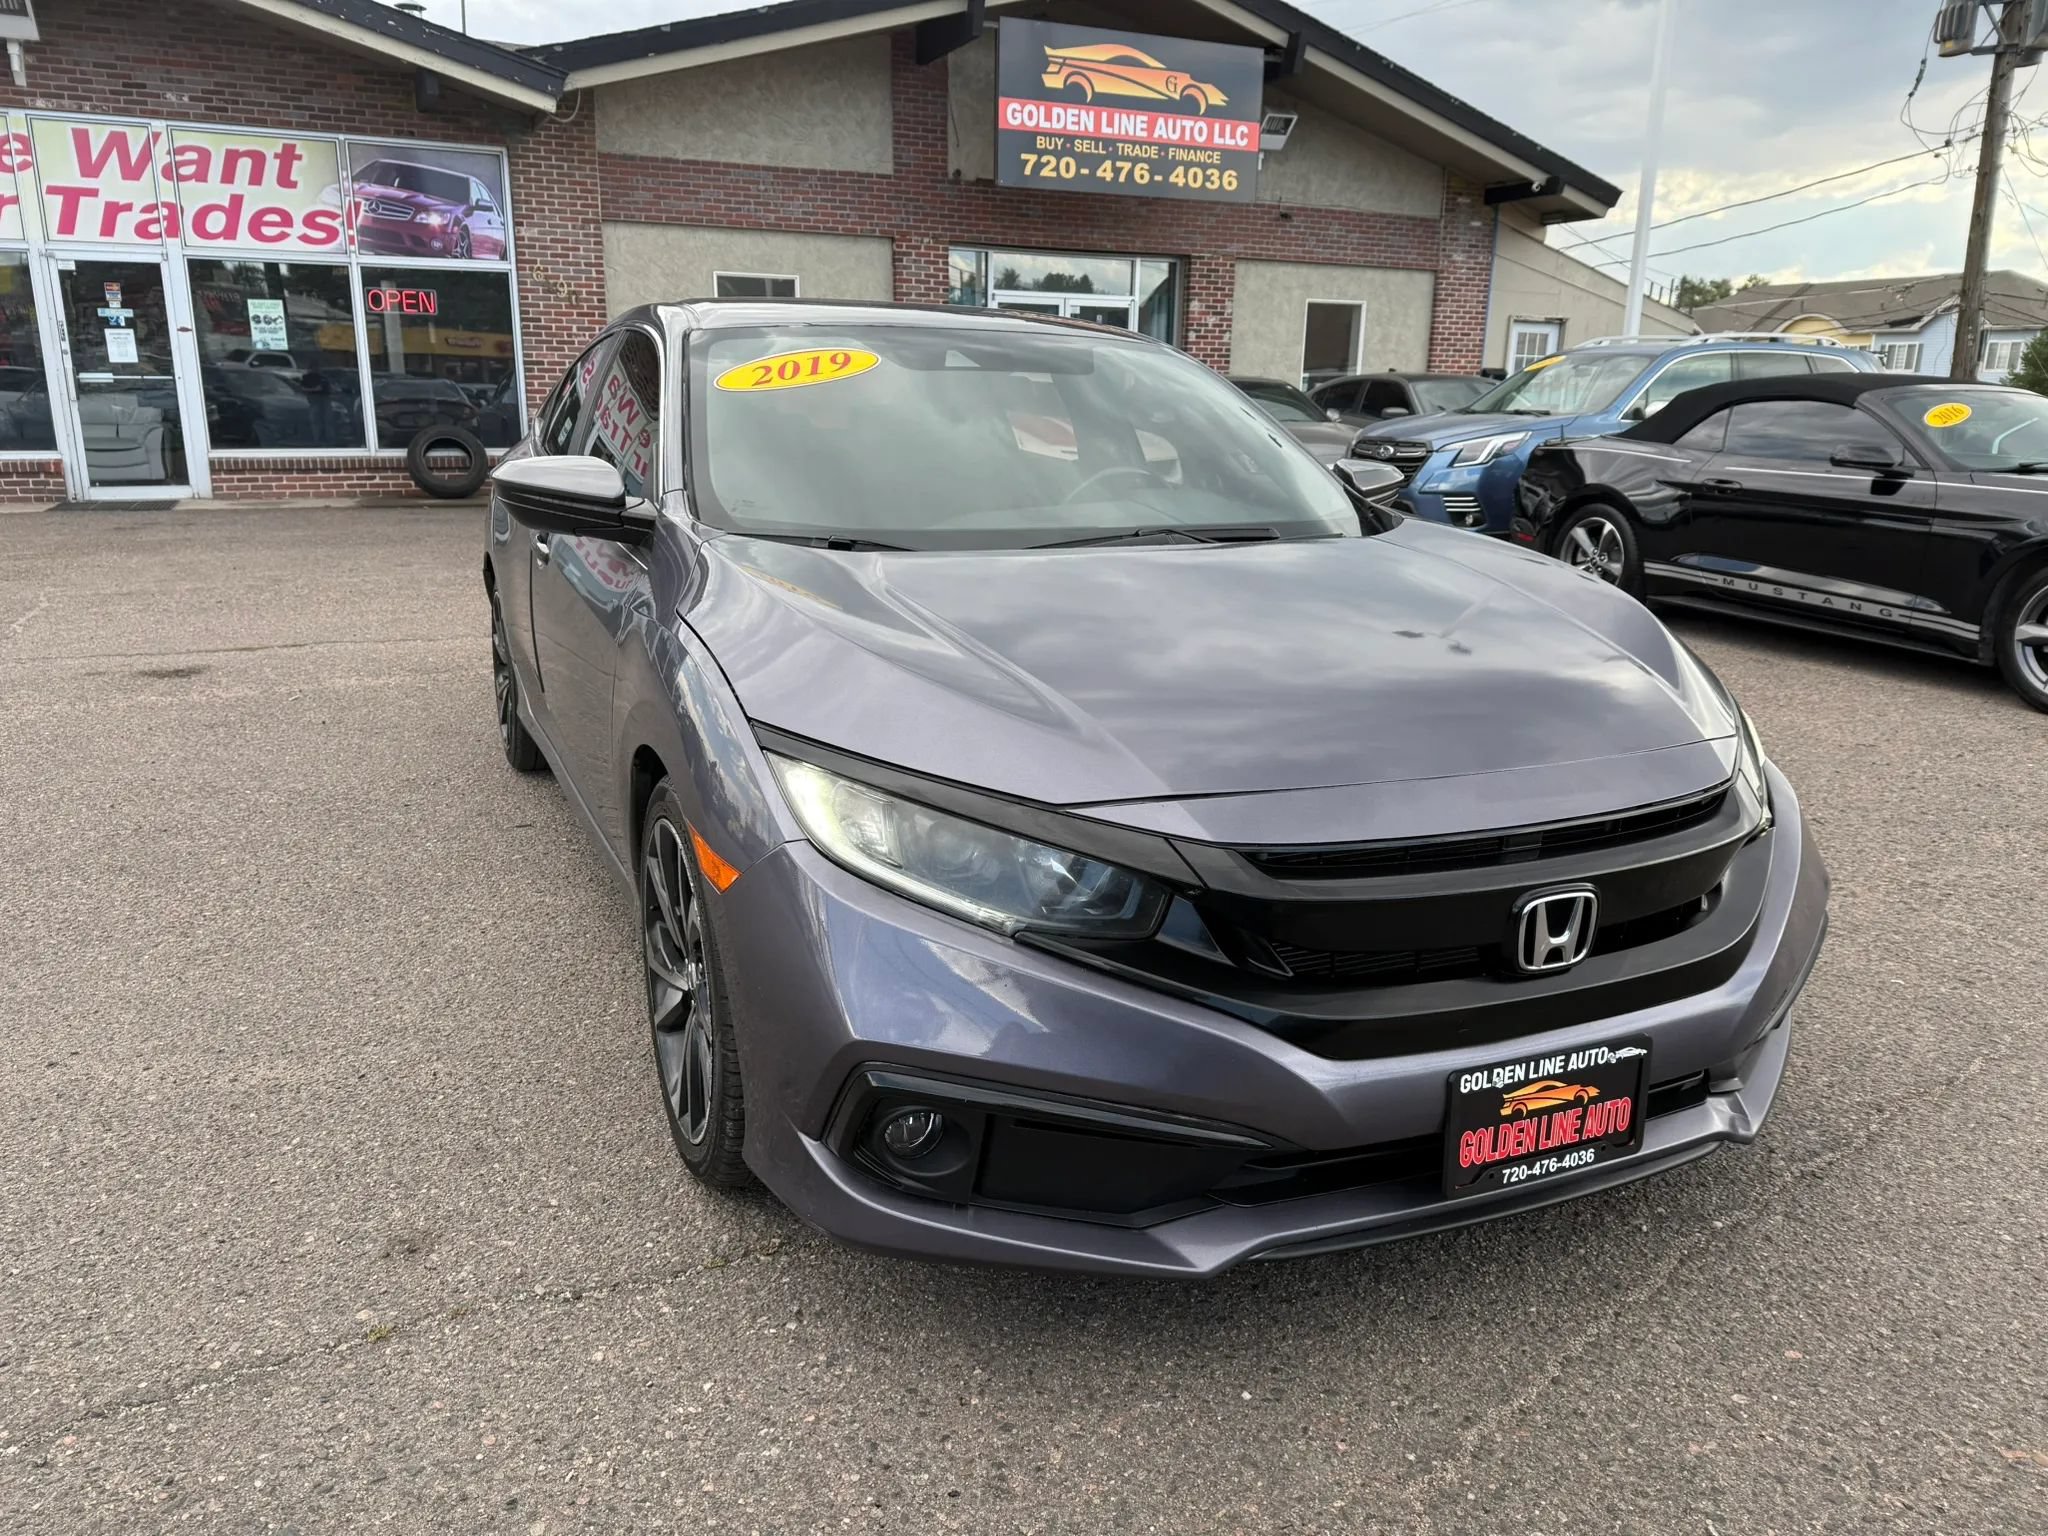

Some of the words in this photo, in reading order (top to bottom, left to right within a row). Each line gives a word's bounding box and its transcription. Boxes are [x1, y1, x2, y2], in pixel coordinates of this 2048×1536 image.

[1006, 102, 1095, 133] GOLDEN
[1101, 112, 1148, 138] LINE
[1153, 117, 1208, 143] AUTO
[1213, 123, 1249, 147] LLC
[71, 127, 303, 190] Want
[1036, 135, 1064, 150] BUY
[1074, 139, 1106, 154] SELL
[1117, 143, 1159, 158] TRADE
[1168, 147, 1222, 164] FINANCE
[45, 184, 363, 247] Trades!
[367, 288, 437, 314] OPEN
[751, 351, 852, 387] 2019
[1933, 404, 1965, 425] 2016
[1722, 577, 1893, 619] MUSTANG
[1459, 1063, 1527, 1094] GOLDEN
[1529, 1055, 1564, 1079] LINE
[1567, 1046, 1609, 1071] AUTO
[1459, 1117, 1538, 1168] GOLDEN
[1538, 1107, 1582, 1150] LINE
[1582, 1097, 1632, 1140] AUTO
[1501, 1148, 1596, 1184] 720-476-4036
